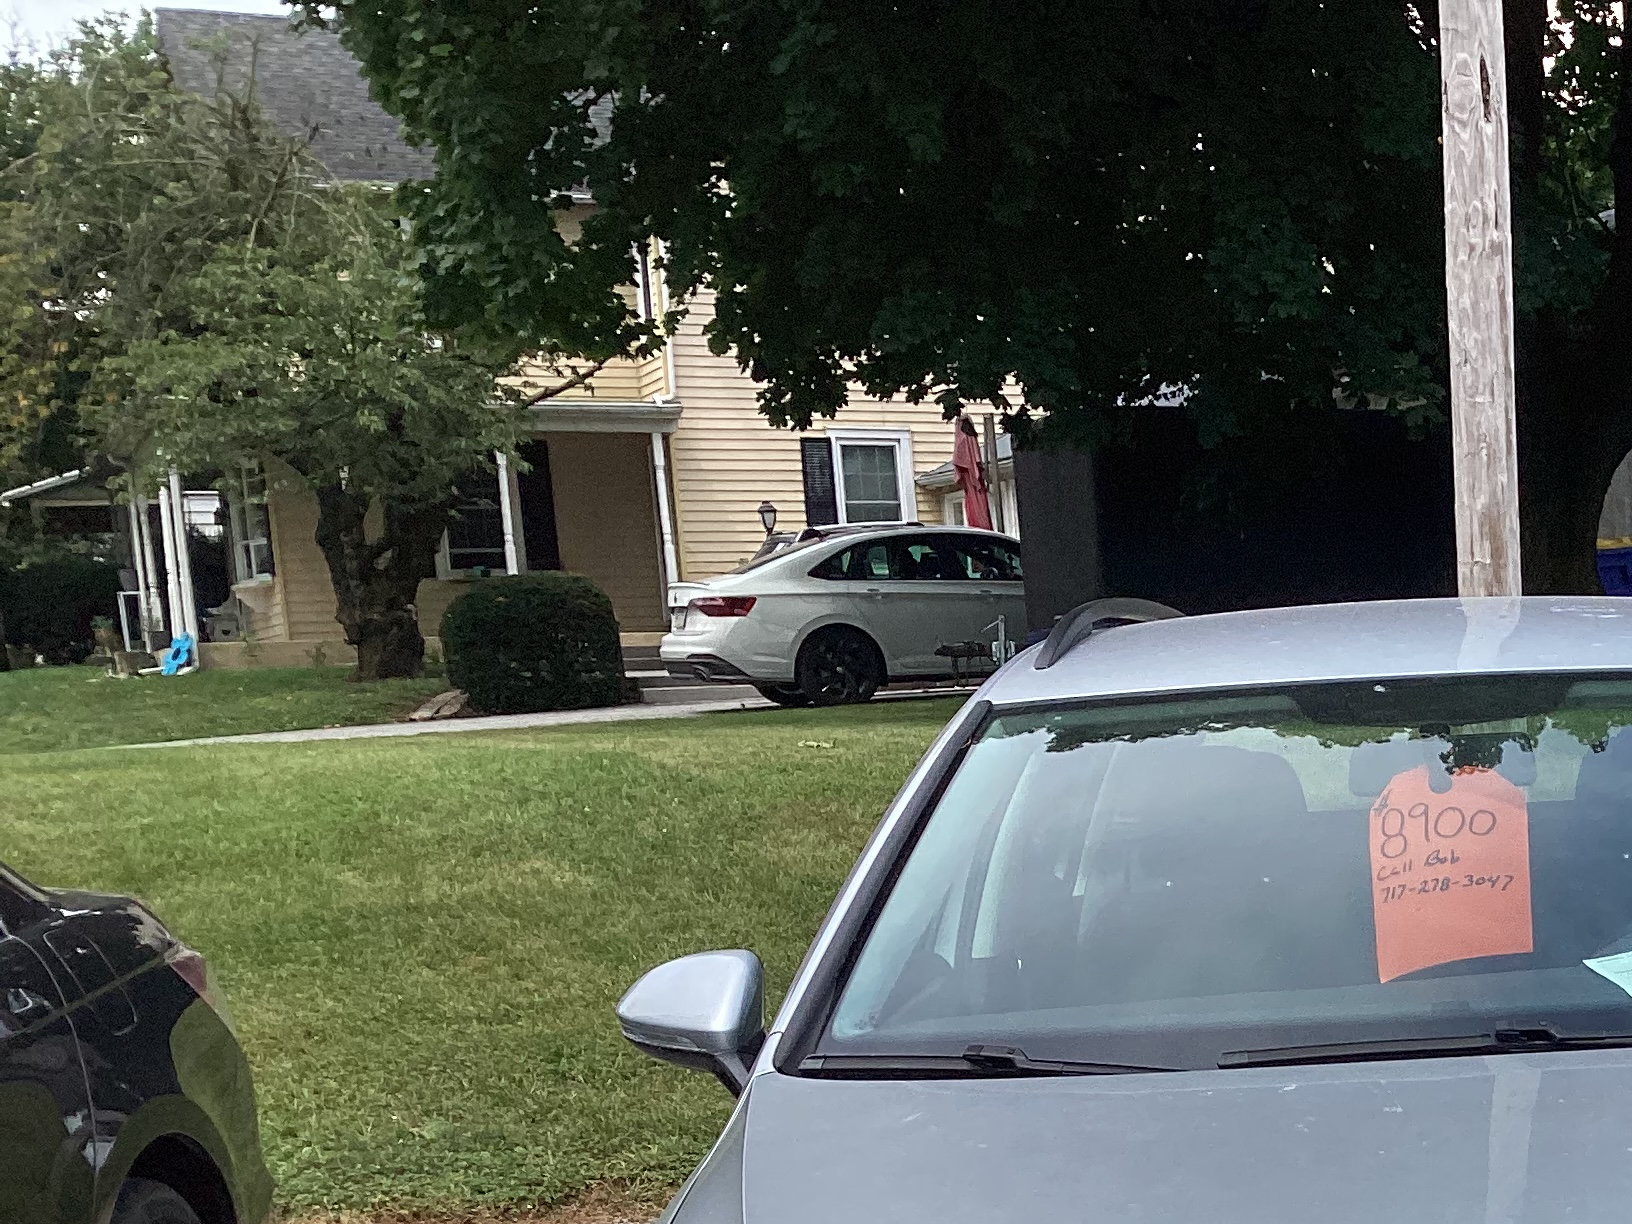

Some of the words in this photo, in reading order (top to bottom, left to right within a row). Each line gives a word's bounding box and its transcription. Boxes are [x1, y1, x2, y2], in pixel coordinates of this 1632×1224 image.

[1377, 859, 1413, 881] Call
[1423, 849, 1461, 867] Bob
[1381, 874, 1515, 904] 717-278-3047
